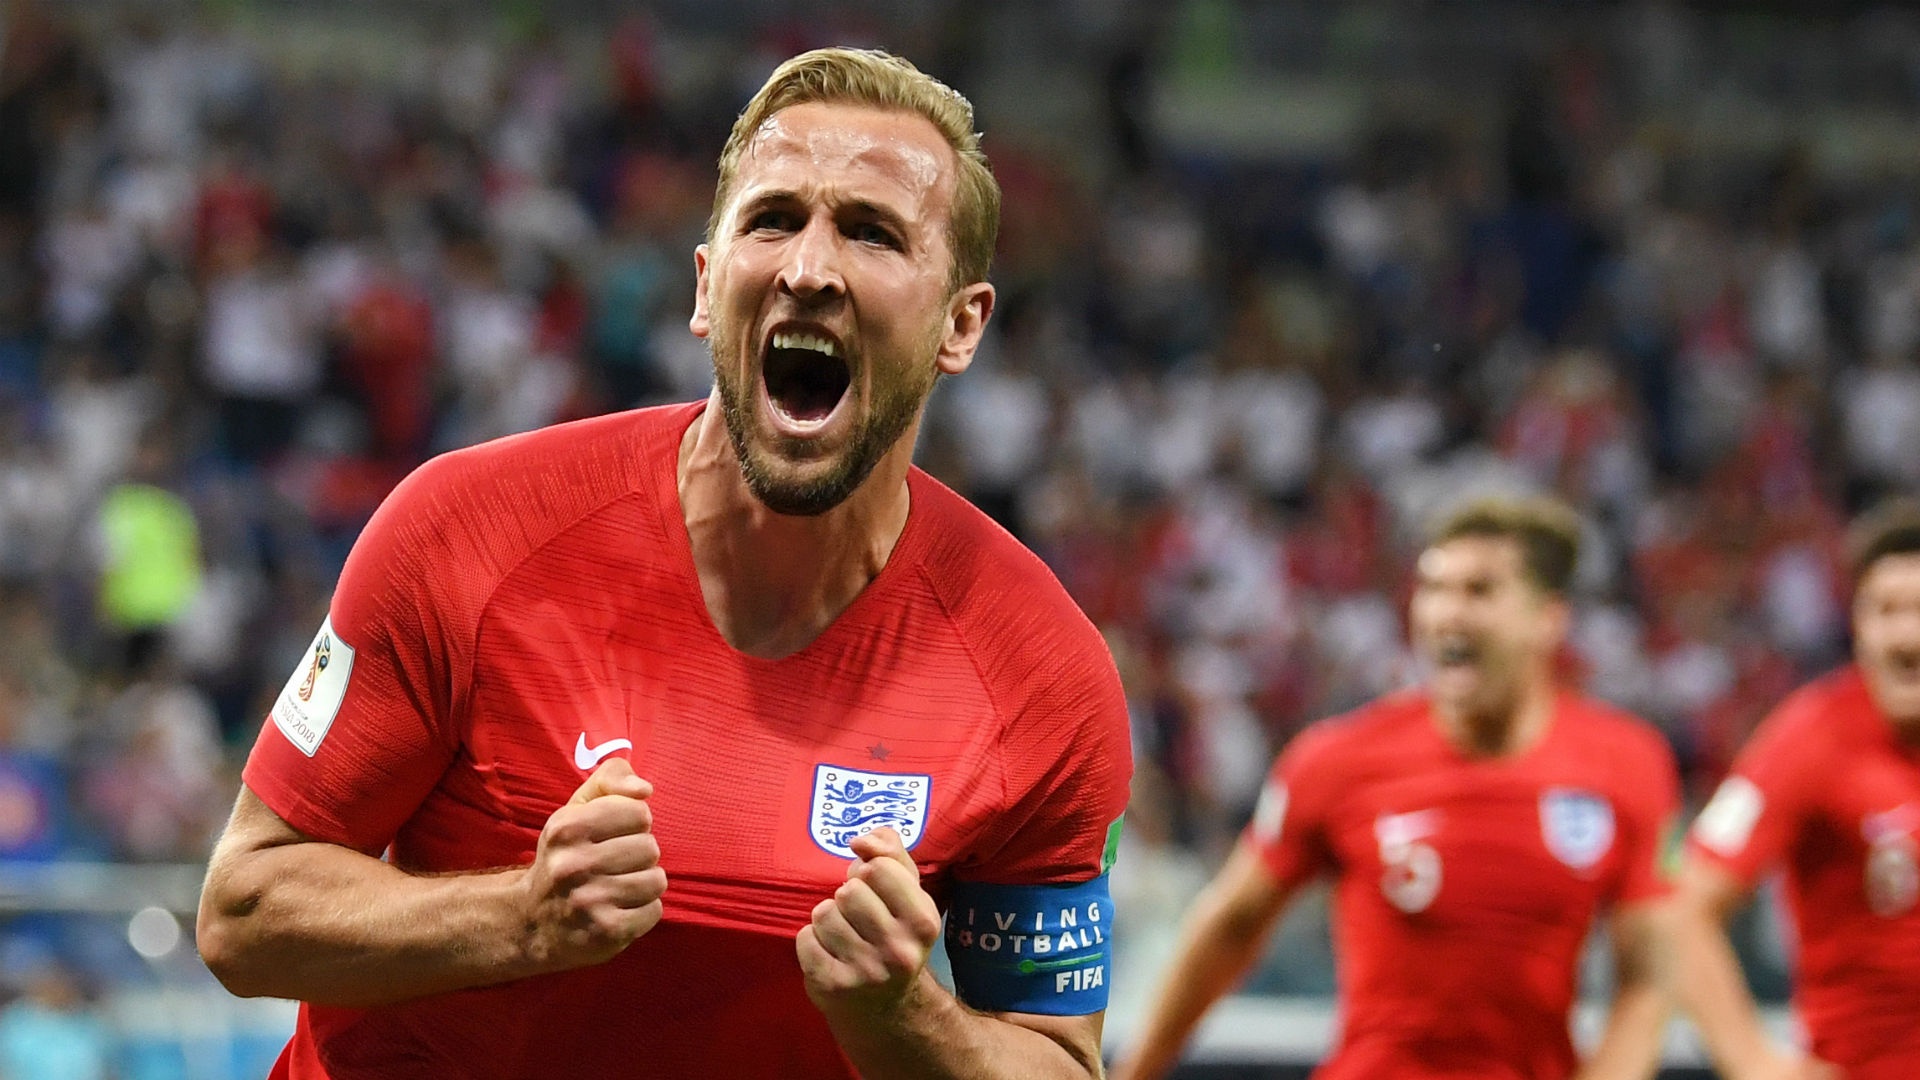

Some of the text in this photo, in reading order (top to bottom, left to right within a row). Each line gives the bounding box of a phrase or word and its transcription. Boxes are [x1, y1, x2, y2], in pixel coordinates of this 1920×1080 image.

[292, 719, 316, 744] 2018
[951, 902, 1100, 931] IVING
[947, 926, 1104, 954] OOTBALL
[1056, 965, 1104, 993] FIFA
